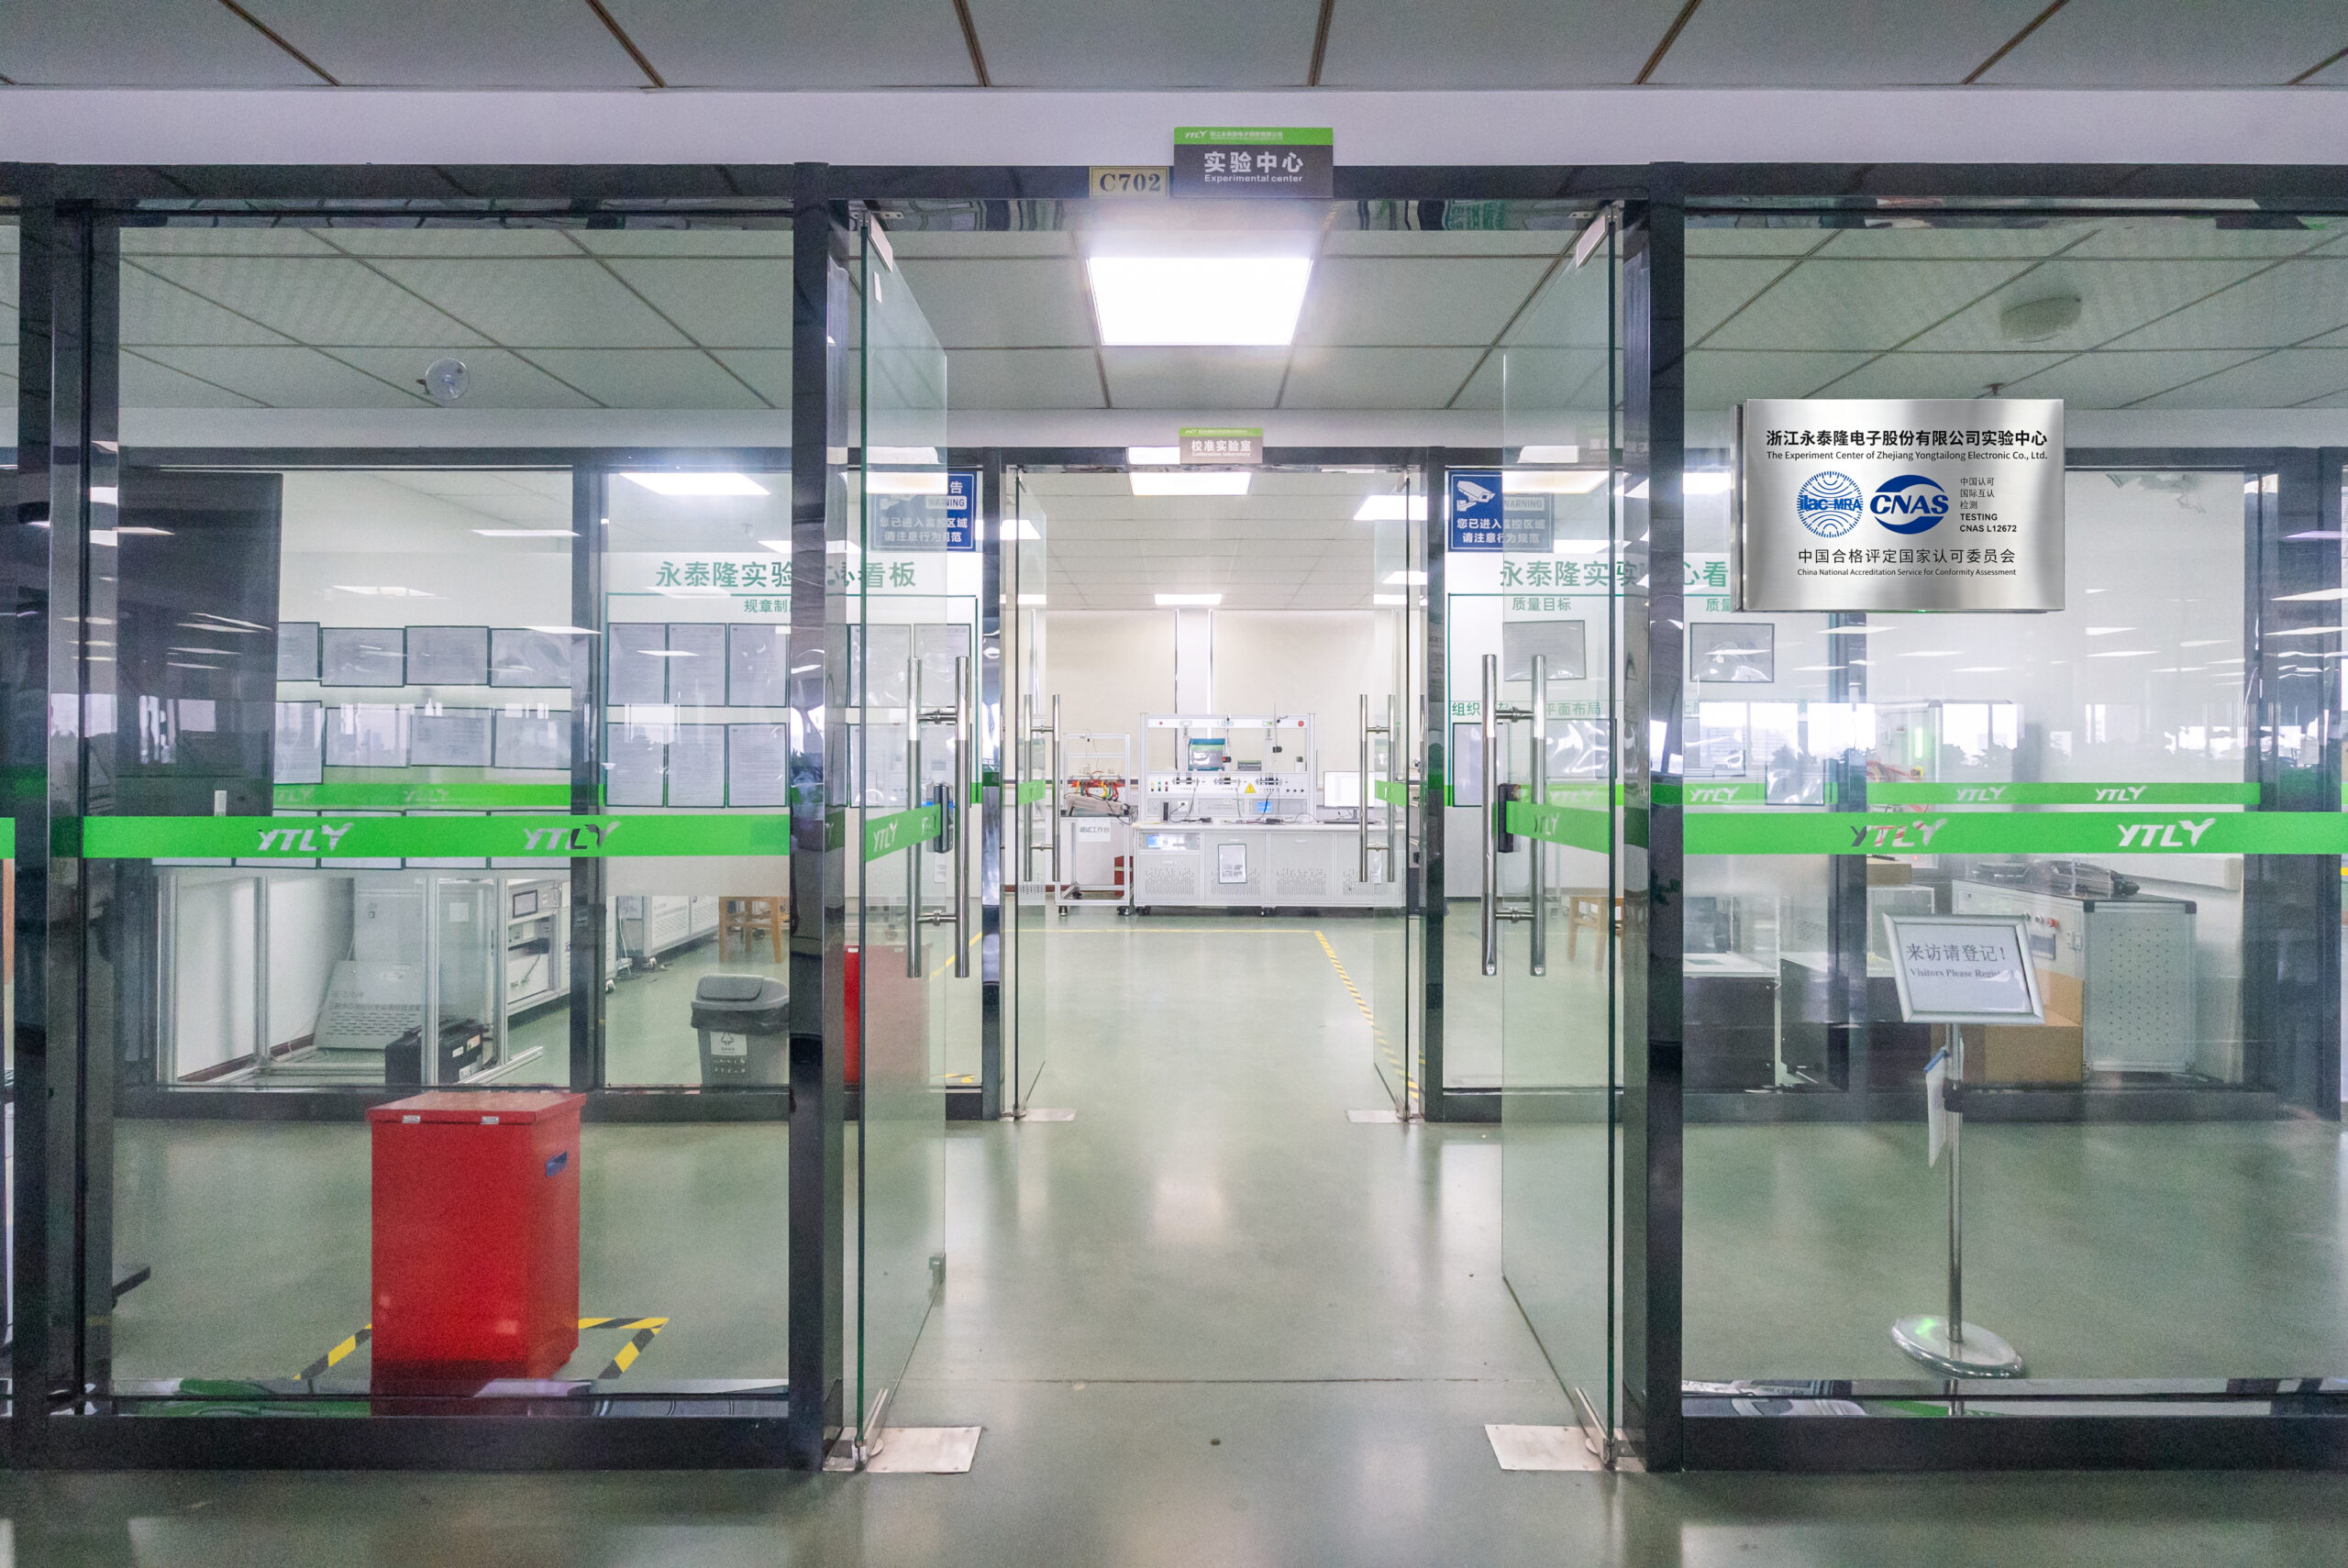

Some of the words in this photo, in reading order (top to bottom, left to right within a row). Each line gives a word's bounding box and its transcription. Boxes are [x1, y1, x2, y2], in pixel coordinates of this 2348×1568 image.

[1204, 151, 1303, 173] 实验中心
[1100, 173, 1160, 192] C702
[1204, 174, 1268, 183] Experimental
[1191, 439, 1251, 452] 校准实验室
[1767, 429, 2048, 447] 浙江永泰隆电子股份有限公司实验中心
[1767, 451, 1783, 459] The
[1785, 451, 1833, 461] Experiment
[1836, 451, 1864, 459] Center
[1866, 450, 1875, 459] of
[1877, 451, 1913, 461] Zhejiang
[1915, 451, 1966, 461] Yongtailong
[1968, 451, 2010, 459] Electronic
[2012, 451, 2029, 460] Co.,
[2032, 451, 2048, 459] Ltd.
[950, 481, 963, 494] 告
[1960, 477, 1995, 487] 中国认可
[1960, 489, 1995, 498] 国际互认
[1870, 494, 1949, 514] CNAS
[1960, 501, 1978, 510] 检测
[1798, 548, 2015, 564] 中国合格评定国家认可委员会
[1934, 569, 1974, 578] Conformity
[744, 599, 792, 613] 规章制
[1512, 597, 1571, 612] 质量目标
[1706, 598, 1732, 613] 质量
[1689, 787, 1740, 802] YTLY
[1956, 785, 2007, 801] YTLY
[2096, 785, 2147, 801] YTLY
[258, 823, 354, 851] YTLY
[524, 822, 621, 851] YTLY
[873, 819, 899, 852] YTLY
[1850, 818, 1947, 847] YTLY
[2117, 818, 2217, 847] YTLY
[1907, 943, 2006, 962] 来访请登记！
[1910, 967, 1944, 977] Visitors
[1946, 968, 1972, 977] Please
